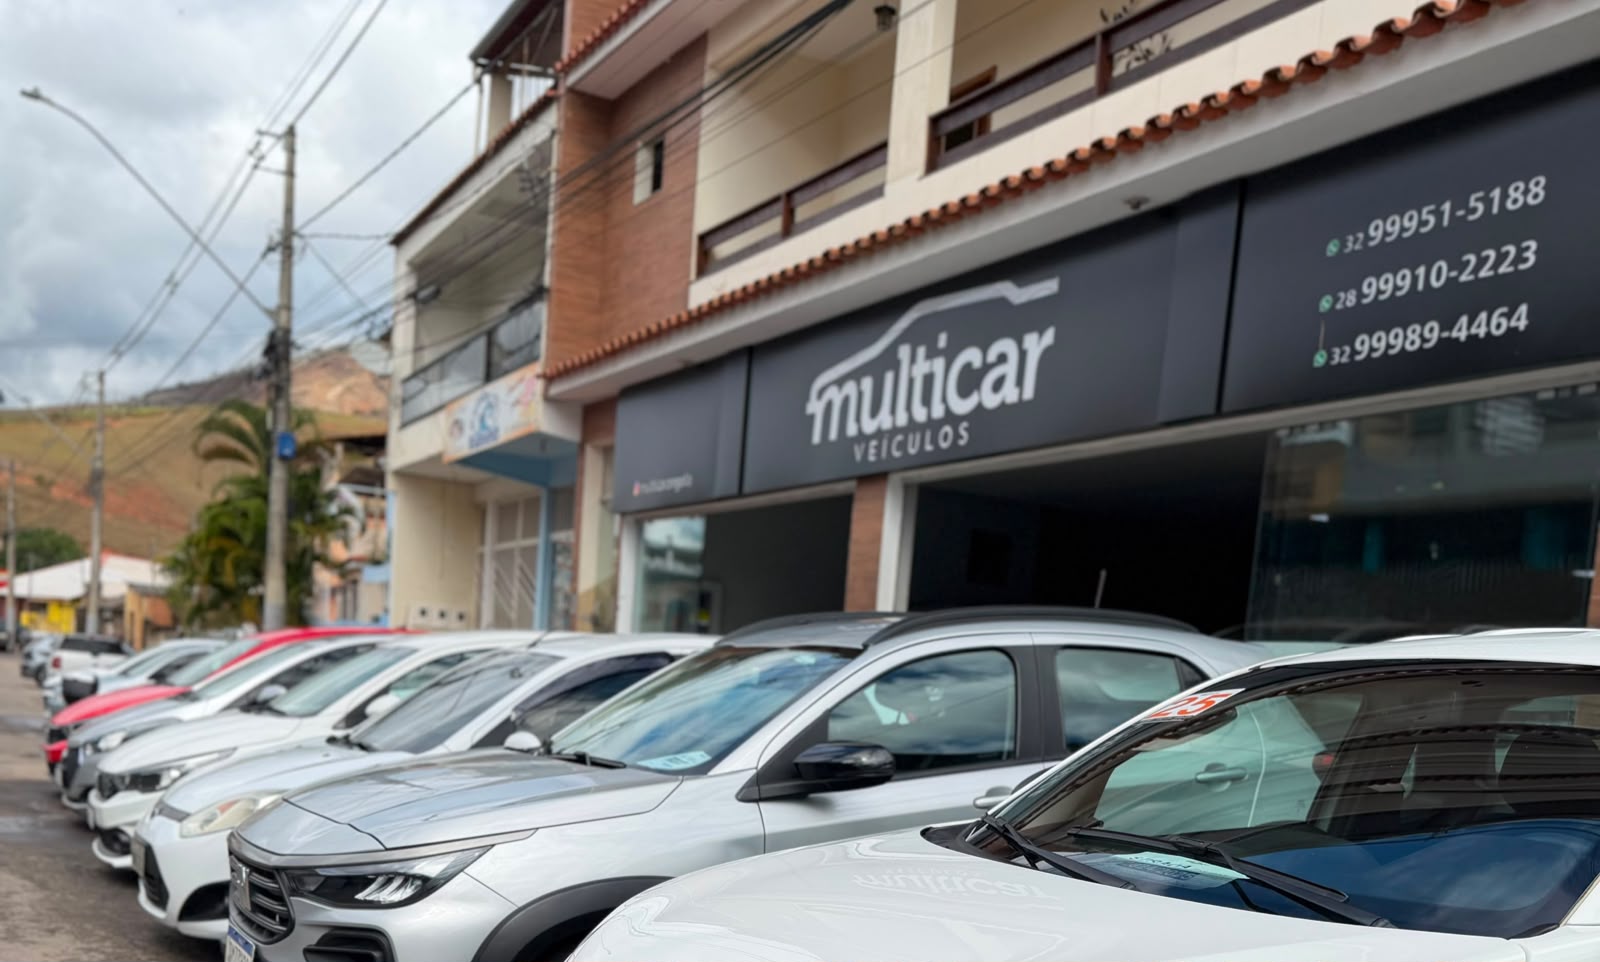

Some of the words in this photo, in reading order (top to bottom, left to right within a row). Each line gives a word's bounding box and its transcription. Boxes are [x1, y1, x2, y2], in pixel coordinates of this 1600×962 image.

[1343, 232, 1364, 254] 32
[1367, 175, 1547, 247] 99951-5188
[1334, 289, 1357, 310] 28
[1361, 239, 1538, 304] 99910-2223
[1329, 346, 1351, 365] 32
[1353, 303, 1530, 361] 99989-4464
[805, 326, 1056, 445] multicar
